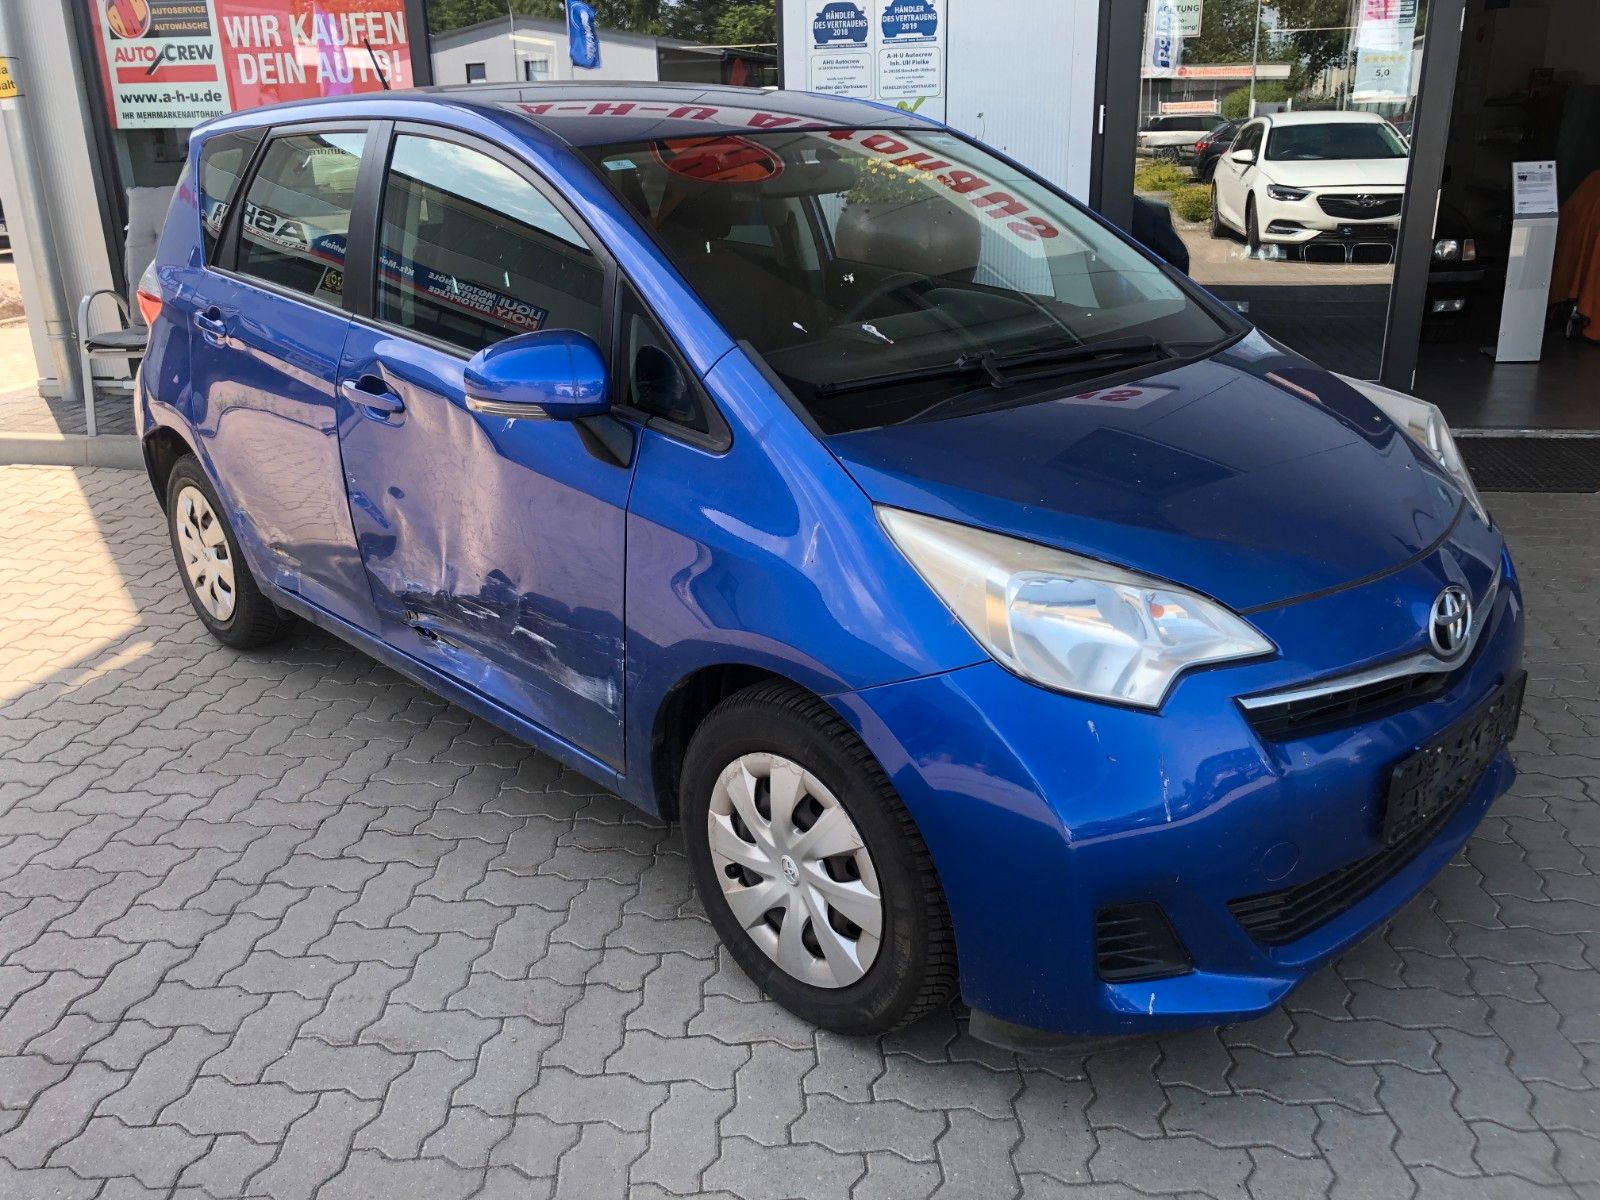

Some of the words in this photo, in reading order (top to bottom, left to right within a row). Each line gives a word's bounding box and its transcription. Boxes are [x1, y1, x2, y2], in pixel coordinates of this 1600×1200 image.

[151, 5, 206, 15] AUTOSERVICE
[894, 5, 924, 13] HÄNDLER
[825, 10, 855, 20] HÄNDLER
[895, 13, 937, 21] VERTRAUENS
[154, 21, 208, 31] AUTOWÄSCHE
[223, 15, 282, 48] WIR
[288, 11, 406, 46] KAUFEN
[814, 21, 826, 29] DES
[827, 20, 867, 28] VERTRAUENS
[833, 28, 849, 36] 2018
[114, 46, 157, 63] AUTO
[164, 43, 214, 61] CREW
[237, 51, 306, 85] DEIN
[316, 50, 403, 84] AUTO!
[1375, 69, 1390, 77] 5,0
[0, 80, 16, 91] alt
[120, 90, 222, 104] www.a-h-u.de
[122, 111, 135, 120] IHR
